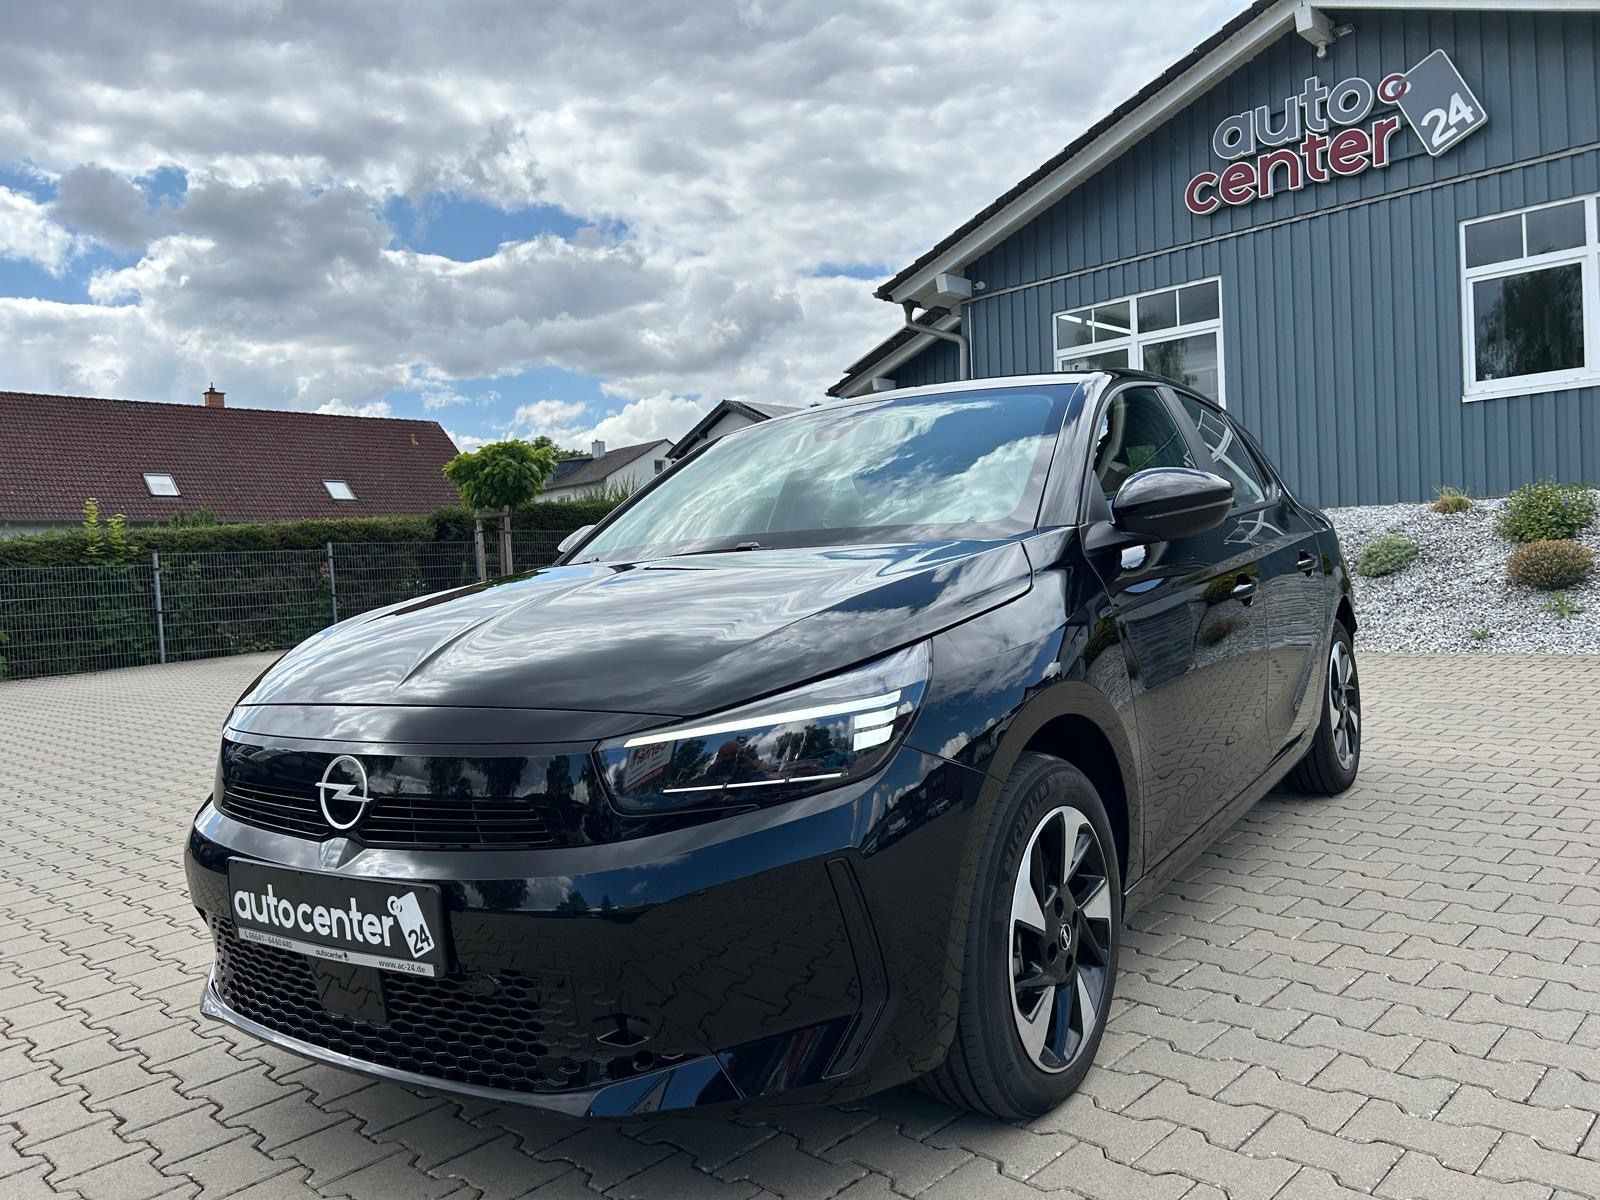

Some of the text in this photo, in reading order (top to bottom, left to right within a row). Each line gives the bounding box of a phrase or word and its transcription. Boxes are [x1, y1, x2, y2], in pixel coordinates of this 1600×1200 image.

[1213, 76, 1374, 160] auto
[1420, 92, 1474, 147] 24
[1185, 115, 1400, 215] center
[407, 923, 431, 953] 24
[378, 960, 426, 973] www.ac-24.de
